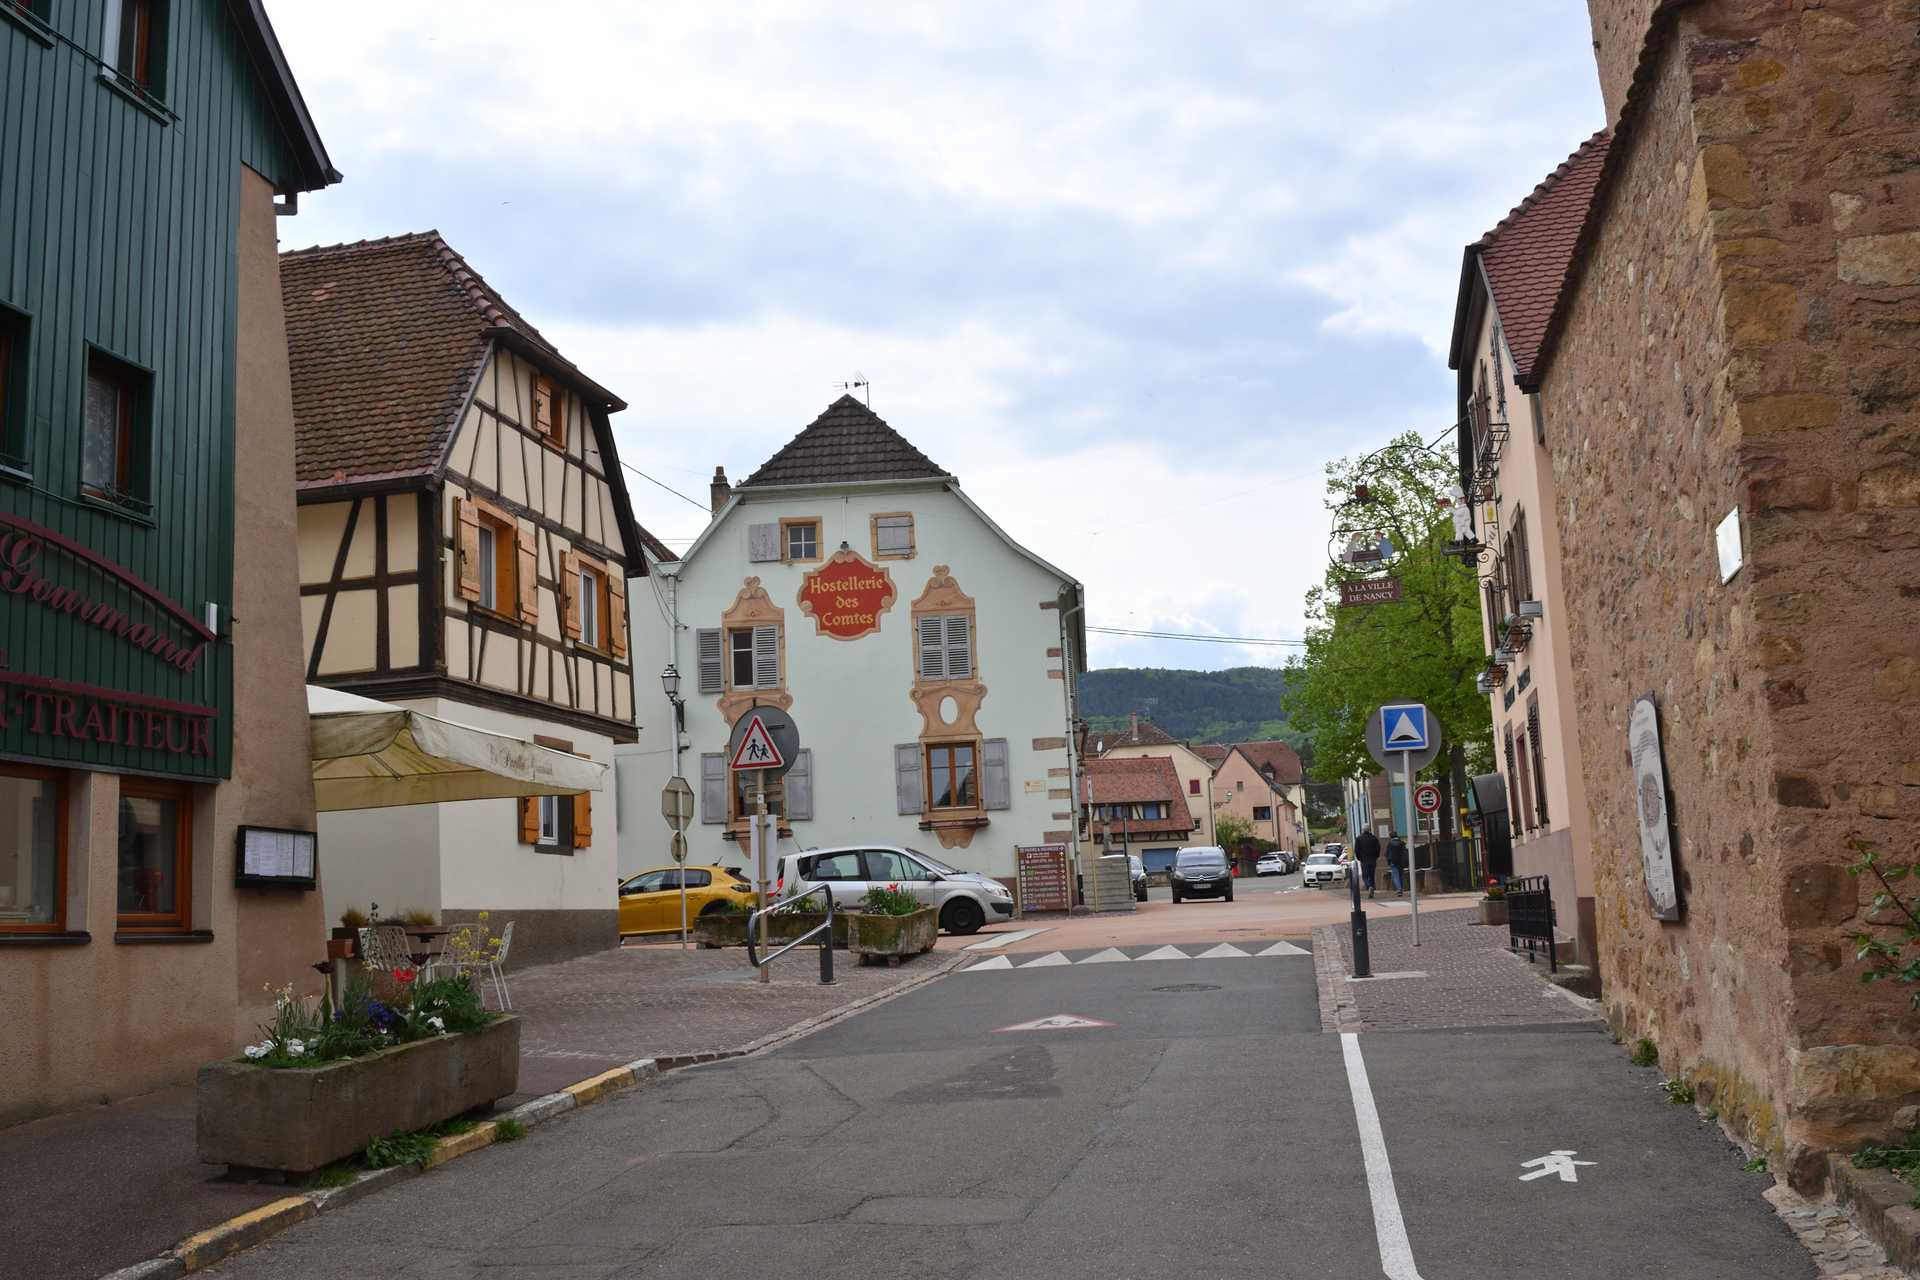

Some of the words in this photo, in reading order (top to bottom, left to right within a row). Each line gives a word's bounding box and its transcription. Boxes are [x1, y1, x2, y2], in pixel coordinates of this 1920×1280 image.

[810, 576, 883, 594] Hostellerie
[1355, 584, 1366, 592] LA
[1368, 582, 1393, 590] VILLE
[0, 532, 205, 673] Gourmand
[835, 595, 859, 608] des
[1363, 592, 1392, 600] NANCY
[822, 612, 874, 626] Comtes
